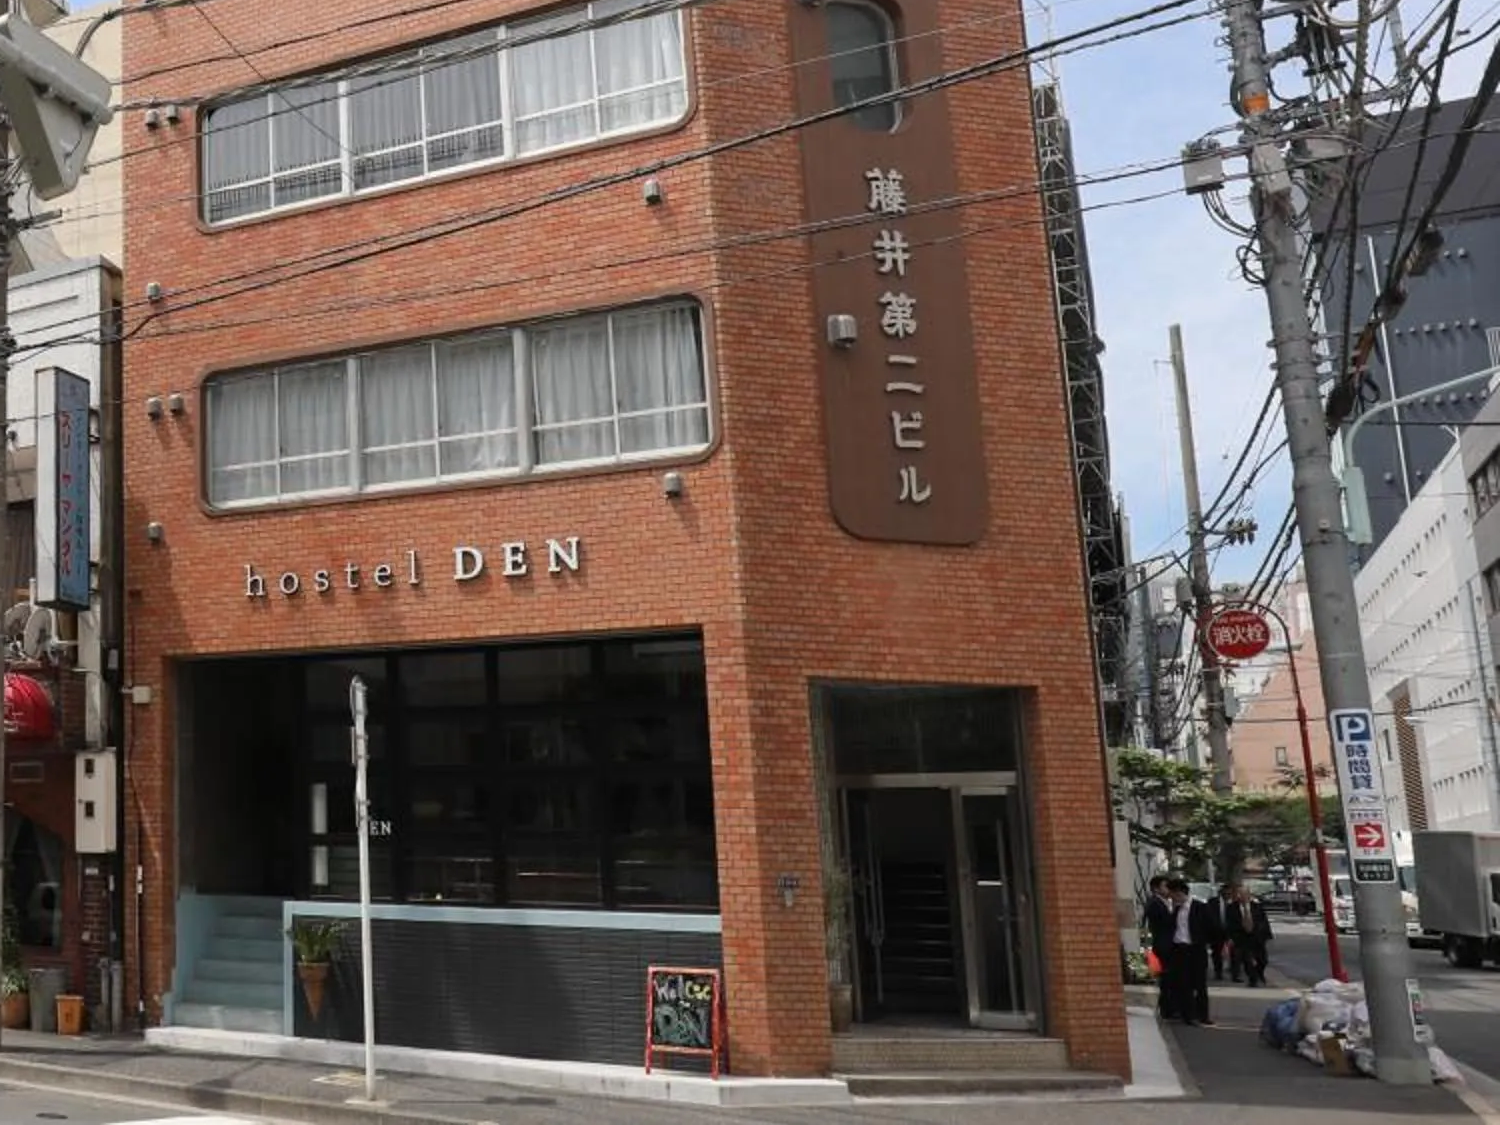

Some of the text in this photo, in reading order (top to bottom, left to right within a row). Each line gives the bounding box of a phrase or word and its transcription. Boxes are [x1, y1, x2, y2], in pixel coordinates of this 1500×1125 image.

[865, 167, 932, 504] 藤井第二ビル
[244, 536, 581, 596] hostel DEN
[1211, 623, 1266, 645] 消火栓
[368, 820, 391, 835] EN
